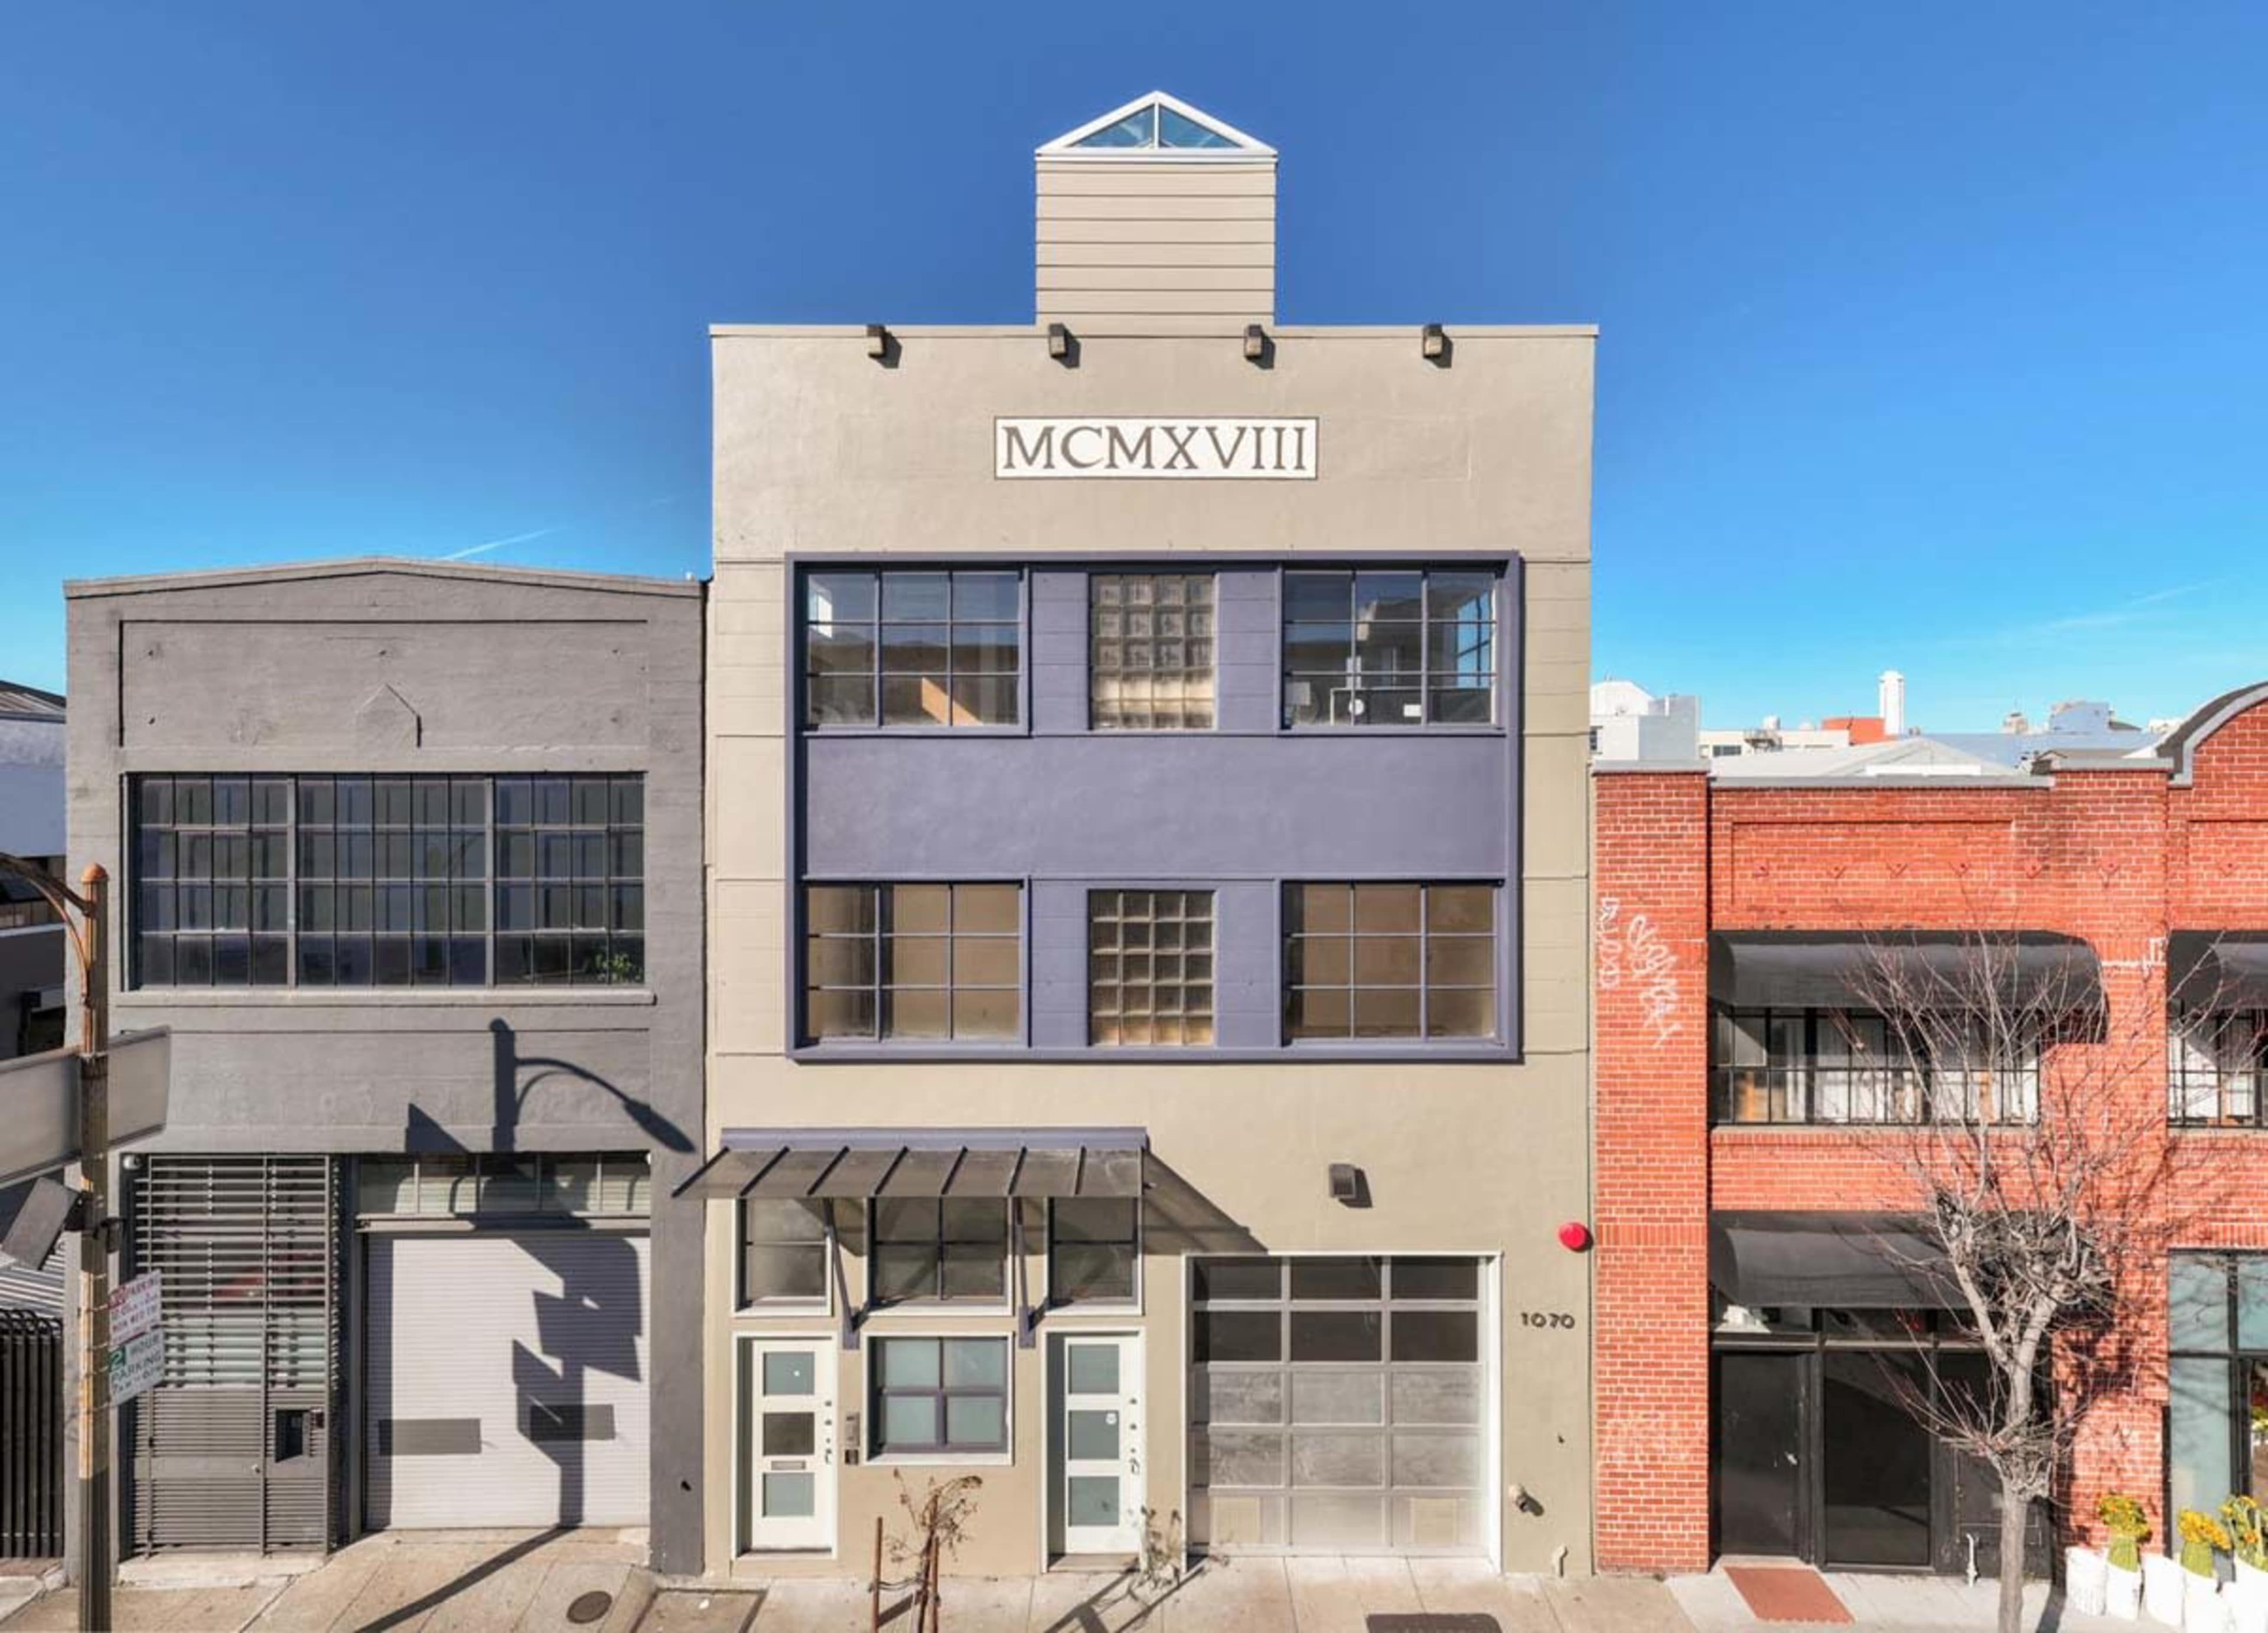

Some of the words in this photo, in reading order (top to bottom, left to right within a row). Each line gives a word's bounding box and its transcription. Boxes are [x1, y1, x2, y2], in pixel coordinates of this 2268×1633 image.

[1002, 425, 1307, 470] MCMXVIII
[1521, 1312, 1575, 1329] 1070
[110, 1350, 123, 1371] 2
[130, 1333, 160, 1357] HOUR
[112, 1350, 161, 1384] PARKING
